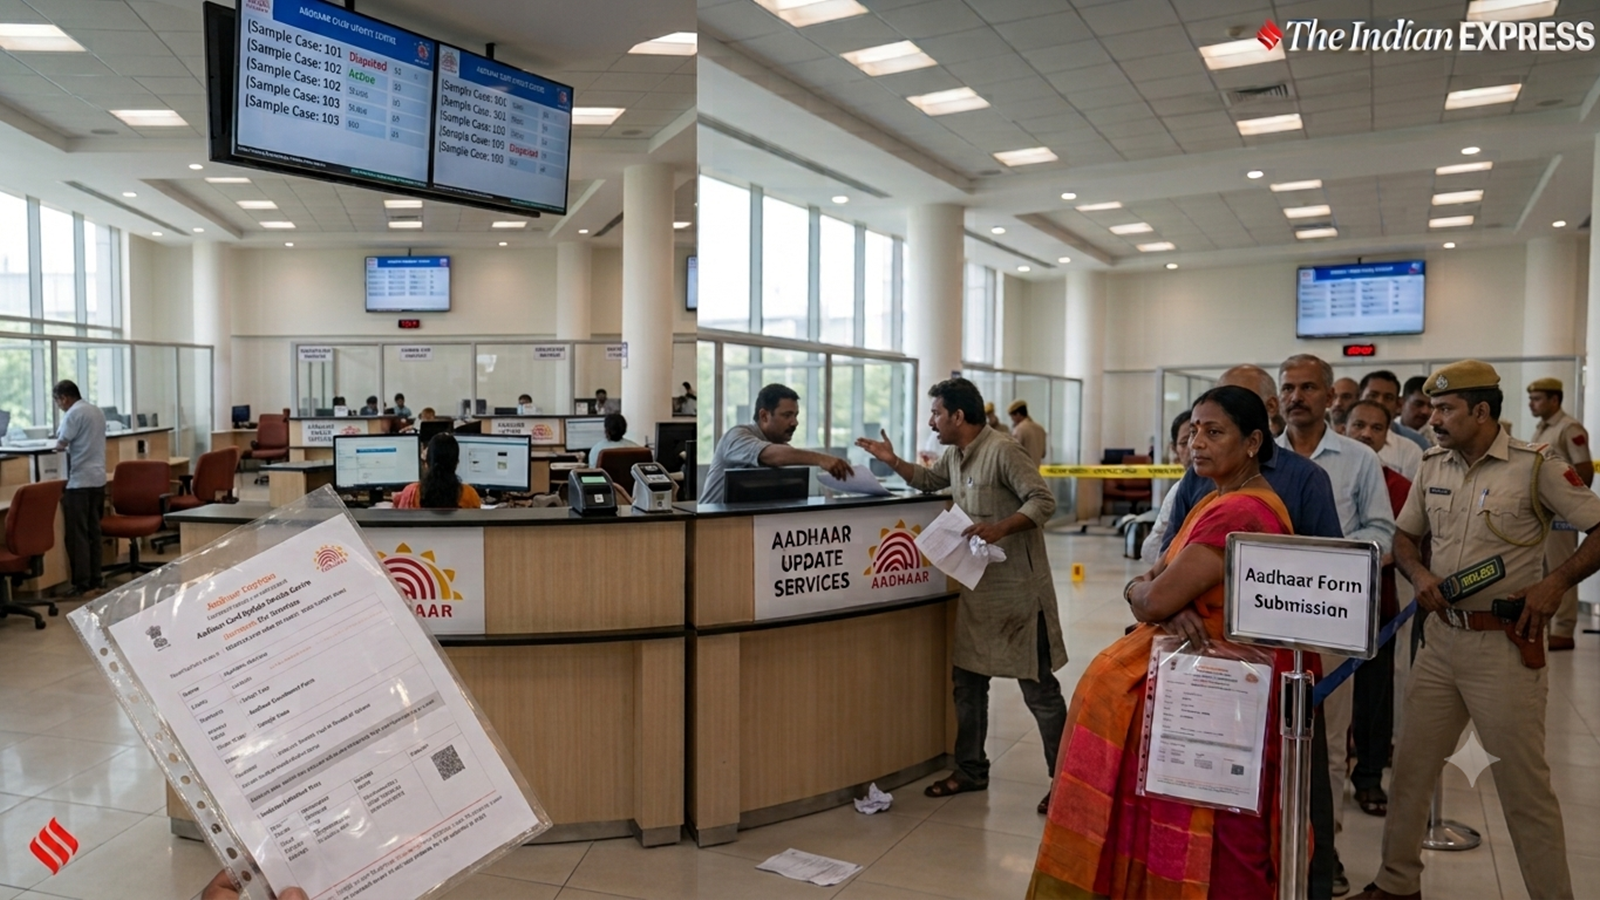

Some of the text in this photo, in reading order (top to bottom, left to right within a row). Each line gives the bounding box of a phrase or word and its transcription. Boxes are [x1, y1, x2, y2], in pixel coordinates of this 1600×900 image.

[295, 34, 322, 52] Case:
[324, 44, 342, 58] 101
[294, 52, 321, 69] Case:
[324, 61, 342, 75] 102
[293, 70, 320, 87] Case:
[323, 78, 341, 92] 102
[292, 87, 320, 104] Case:
[322, 95, 340, 109] 103
[292, 105, 319, 121] Case:
[322, 112, 340, 126] 103
[771, 525, 852, 550] AADHAAR
[781, 549, 844, 572] UPDATE
[774, 571, 850, 597] SERVICES
[871, 571, 930, 589] AADHAAR
[1245, 567, 1362, 593] Aadhaar Form
